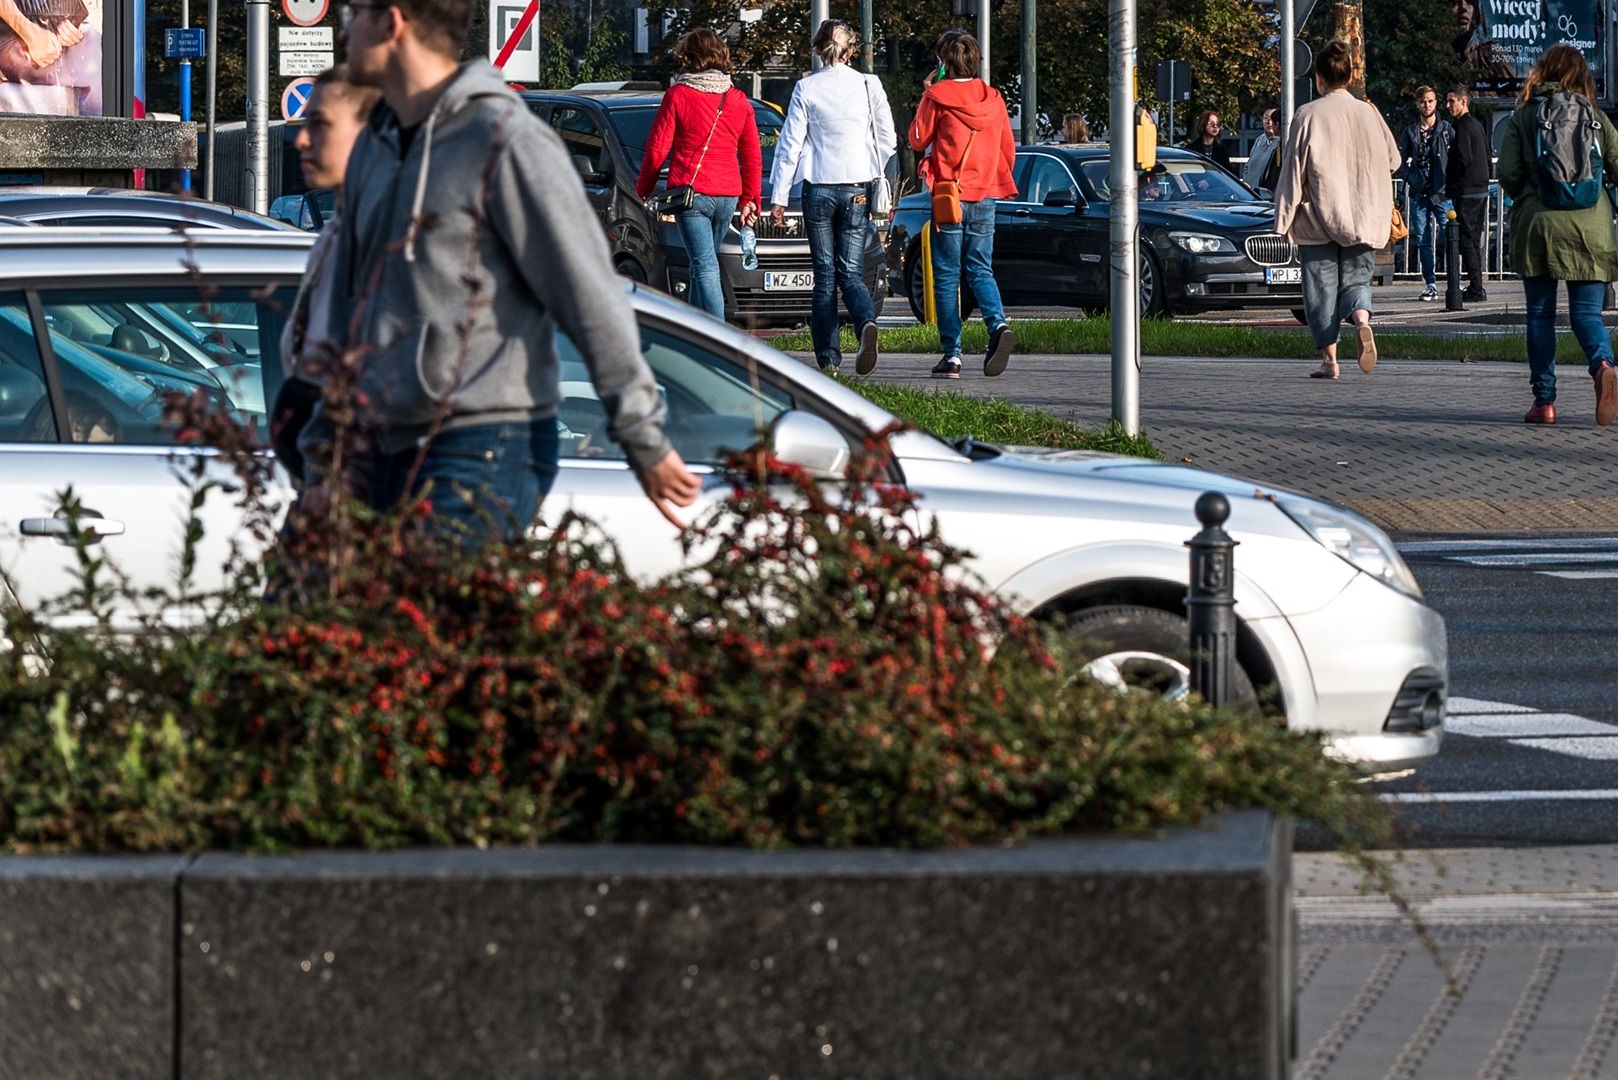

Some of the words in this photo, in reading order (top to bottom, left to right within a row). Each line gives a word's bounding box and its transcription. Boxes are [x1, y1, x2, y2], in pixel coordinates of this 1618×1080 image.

[1491, 18, 1546, 45] mody!
[772, 273, 788, 287] WZ
[791, 273, 814, 287] 450
